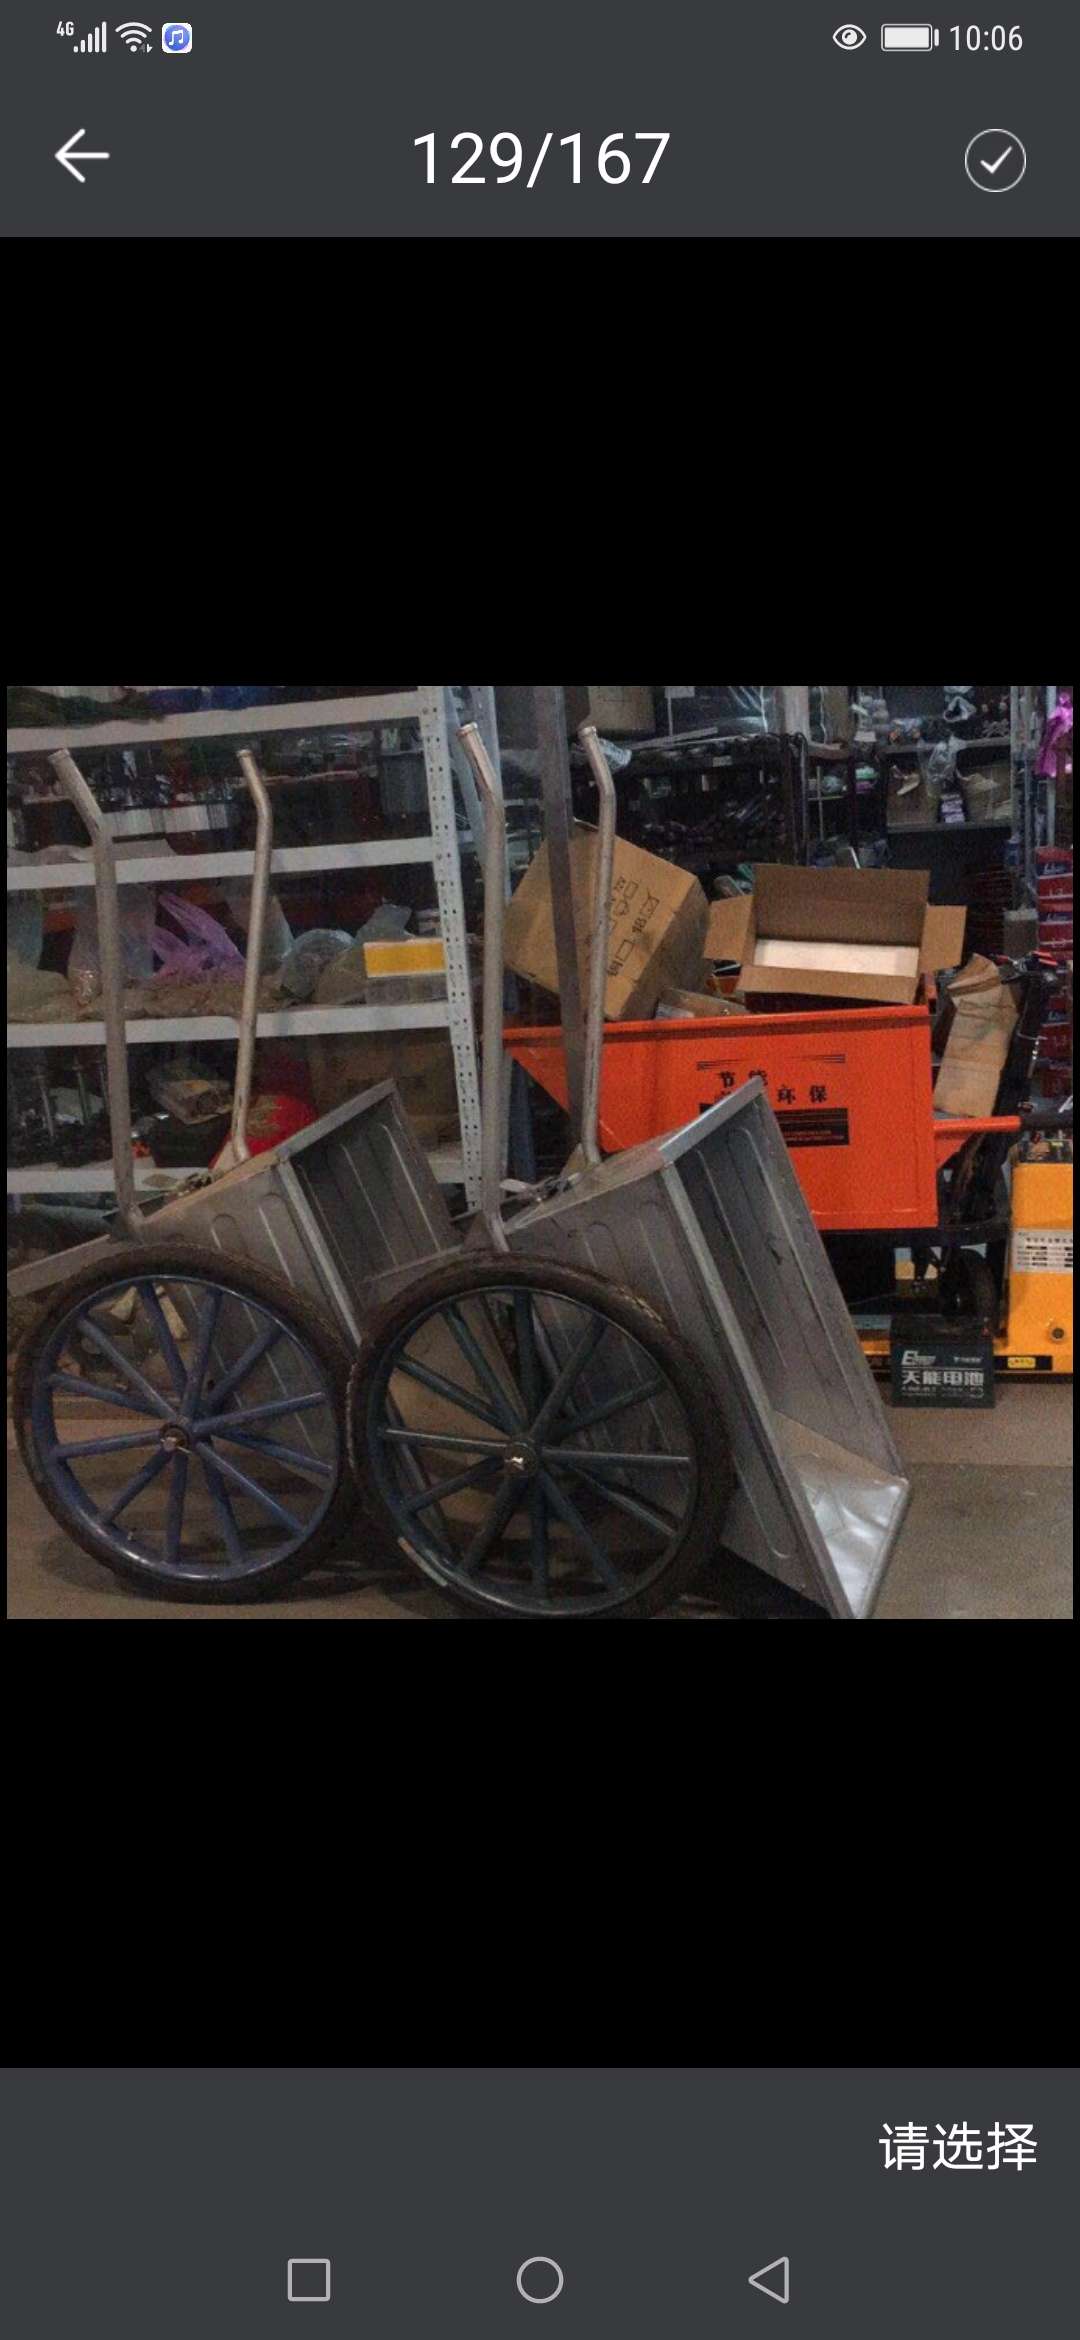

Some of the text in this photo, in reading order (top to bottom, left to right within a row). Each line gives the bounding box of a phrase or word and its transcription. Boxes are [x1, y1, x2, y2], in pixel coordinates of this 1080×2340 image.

[56, 20, 75, 37] 4G
[949, 24, 1023, 52] 10:06
[413, 131, 671, 189] 129/167
[776, 1084, 828, 1104] 环保
[901, 1369, 985, 1386] 天能电池
[878, 2120, 1038, 2172] 请选择
